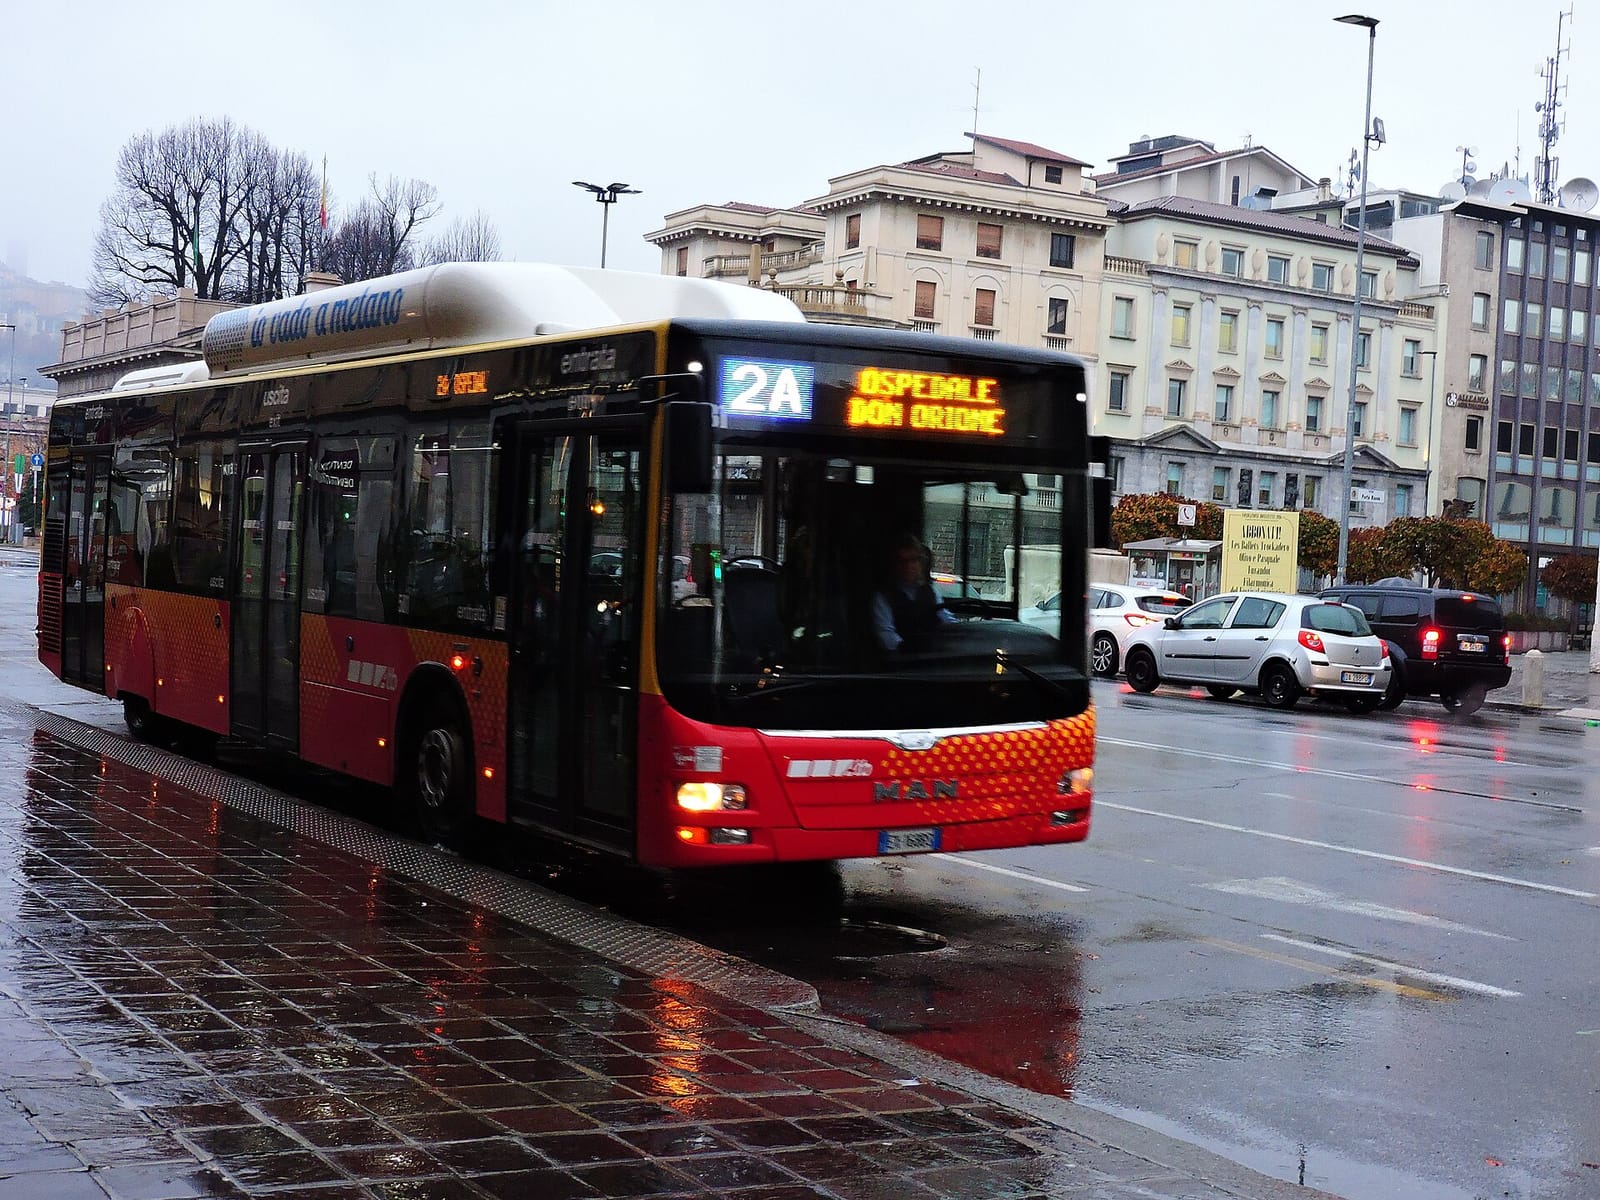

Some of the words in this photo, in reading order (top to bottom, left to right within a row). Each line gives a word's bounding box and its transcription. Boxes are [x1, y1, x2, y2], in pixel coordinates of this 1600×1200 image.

[269, 298, 313, 344] vado
[315, 302, 330, 336] a
[330, 286, 404, 334] metano
[731, 364, 801, 414] 2A
[858, 366, 997, 404] OSPEDALE
[848, 397, 903, 427] DON
[874, 778, 959, 803] MAN
